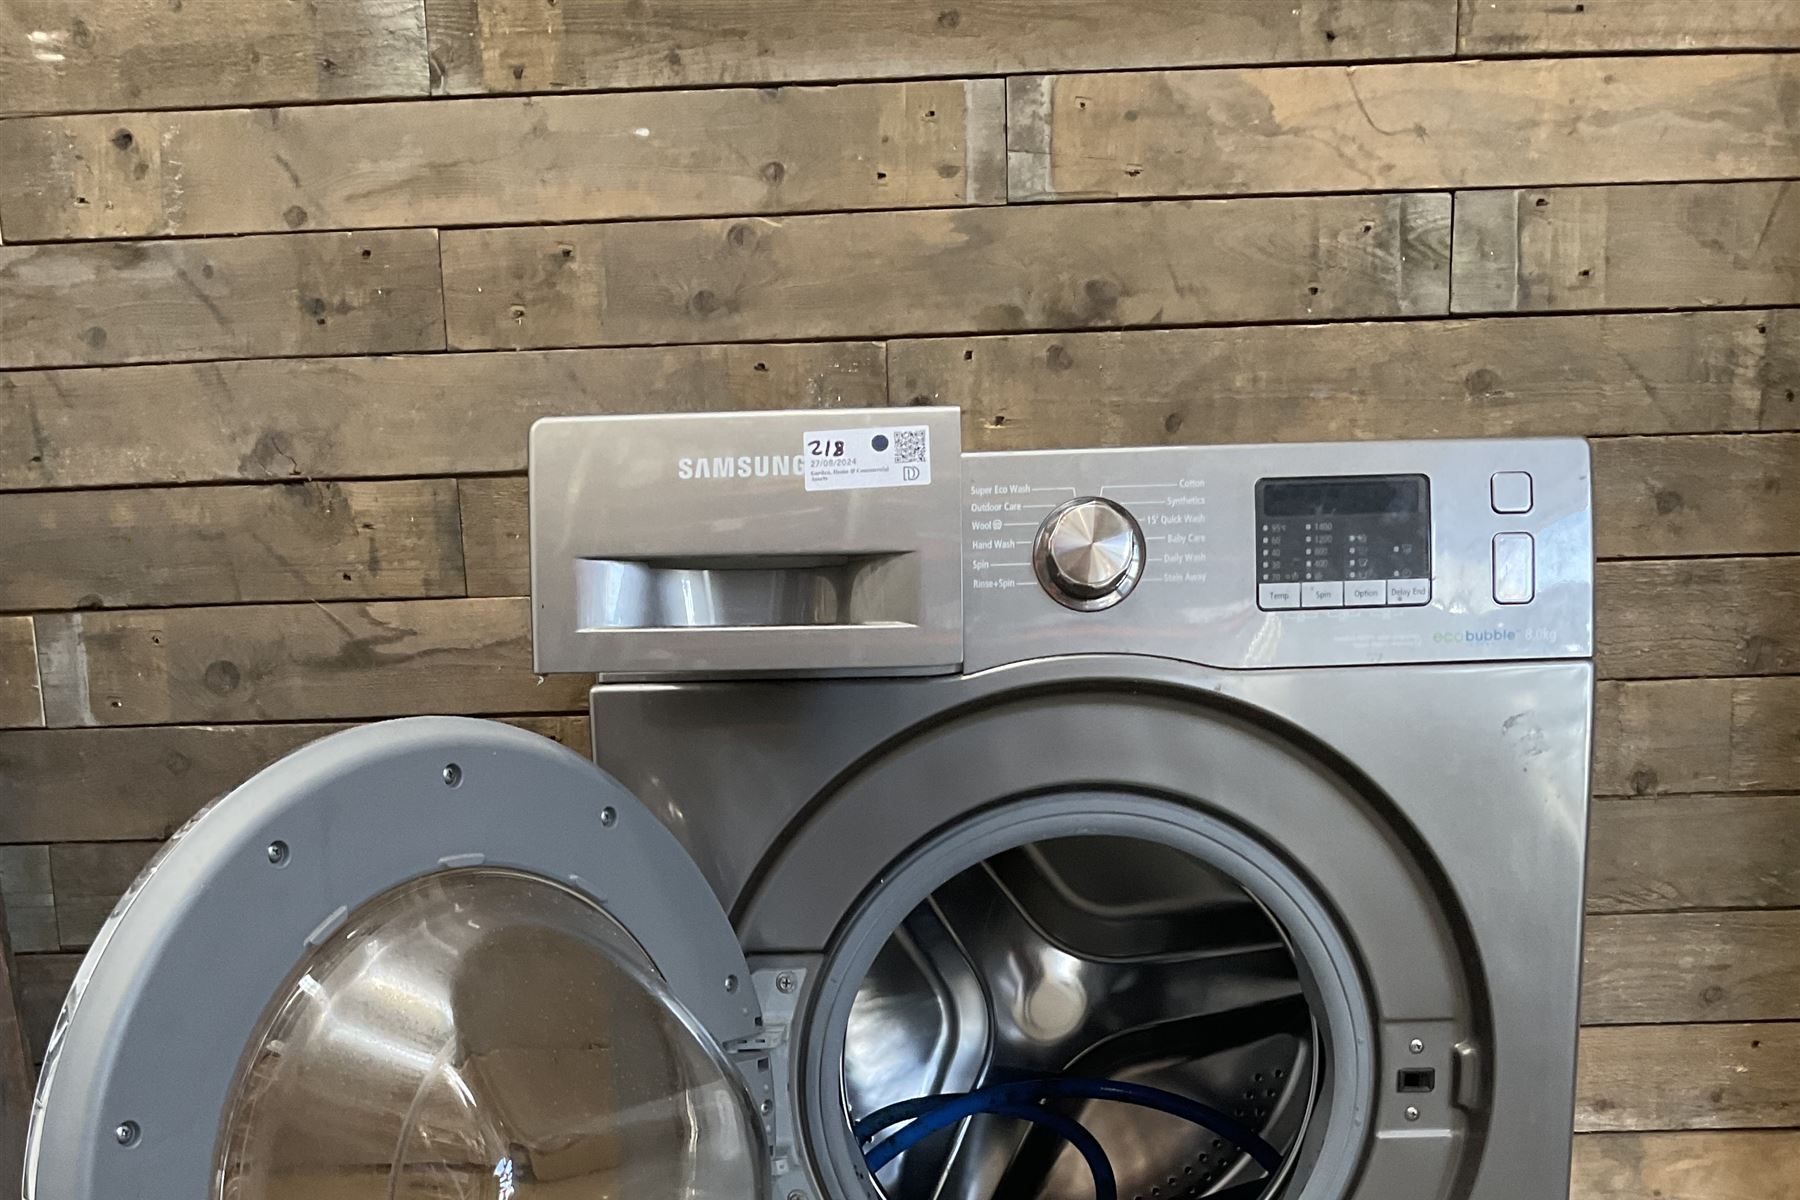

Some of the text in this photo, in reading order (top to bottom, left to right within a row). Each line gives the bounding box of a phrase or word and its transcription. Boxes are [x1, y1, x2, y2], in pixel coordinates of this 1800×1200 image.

[808, 440, 844, 457] 218
[678, 455, 804, 480] SAMSUNG
[1179, 478, 1205, 488] Cotton
[970, 484, 1031, 496] Super Eco Wash
[971, 502, 1022, 512] Outdoor Care
[1167, 496, 1206, 508] Synthetics
[971, 520, 992, 530] Wool
[1160, 514, 1182, 526] Quick
[1183, 514, 1206, 524] Wash
[972, 538, 1015, 549] Hand Wash
[972, 560, 989, 571] Spin
[973, 578, 1015, 590] Rinse+Spin
[1354, 589, 1378, 598] Option
[1391, 587, 1426, 597] Delay End
